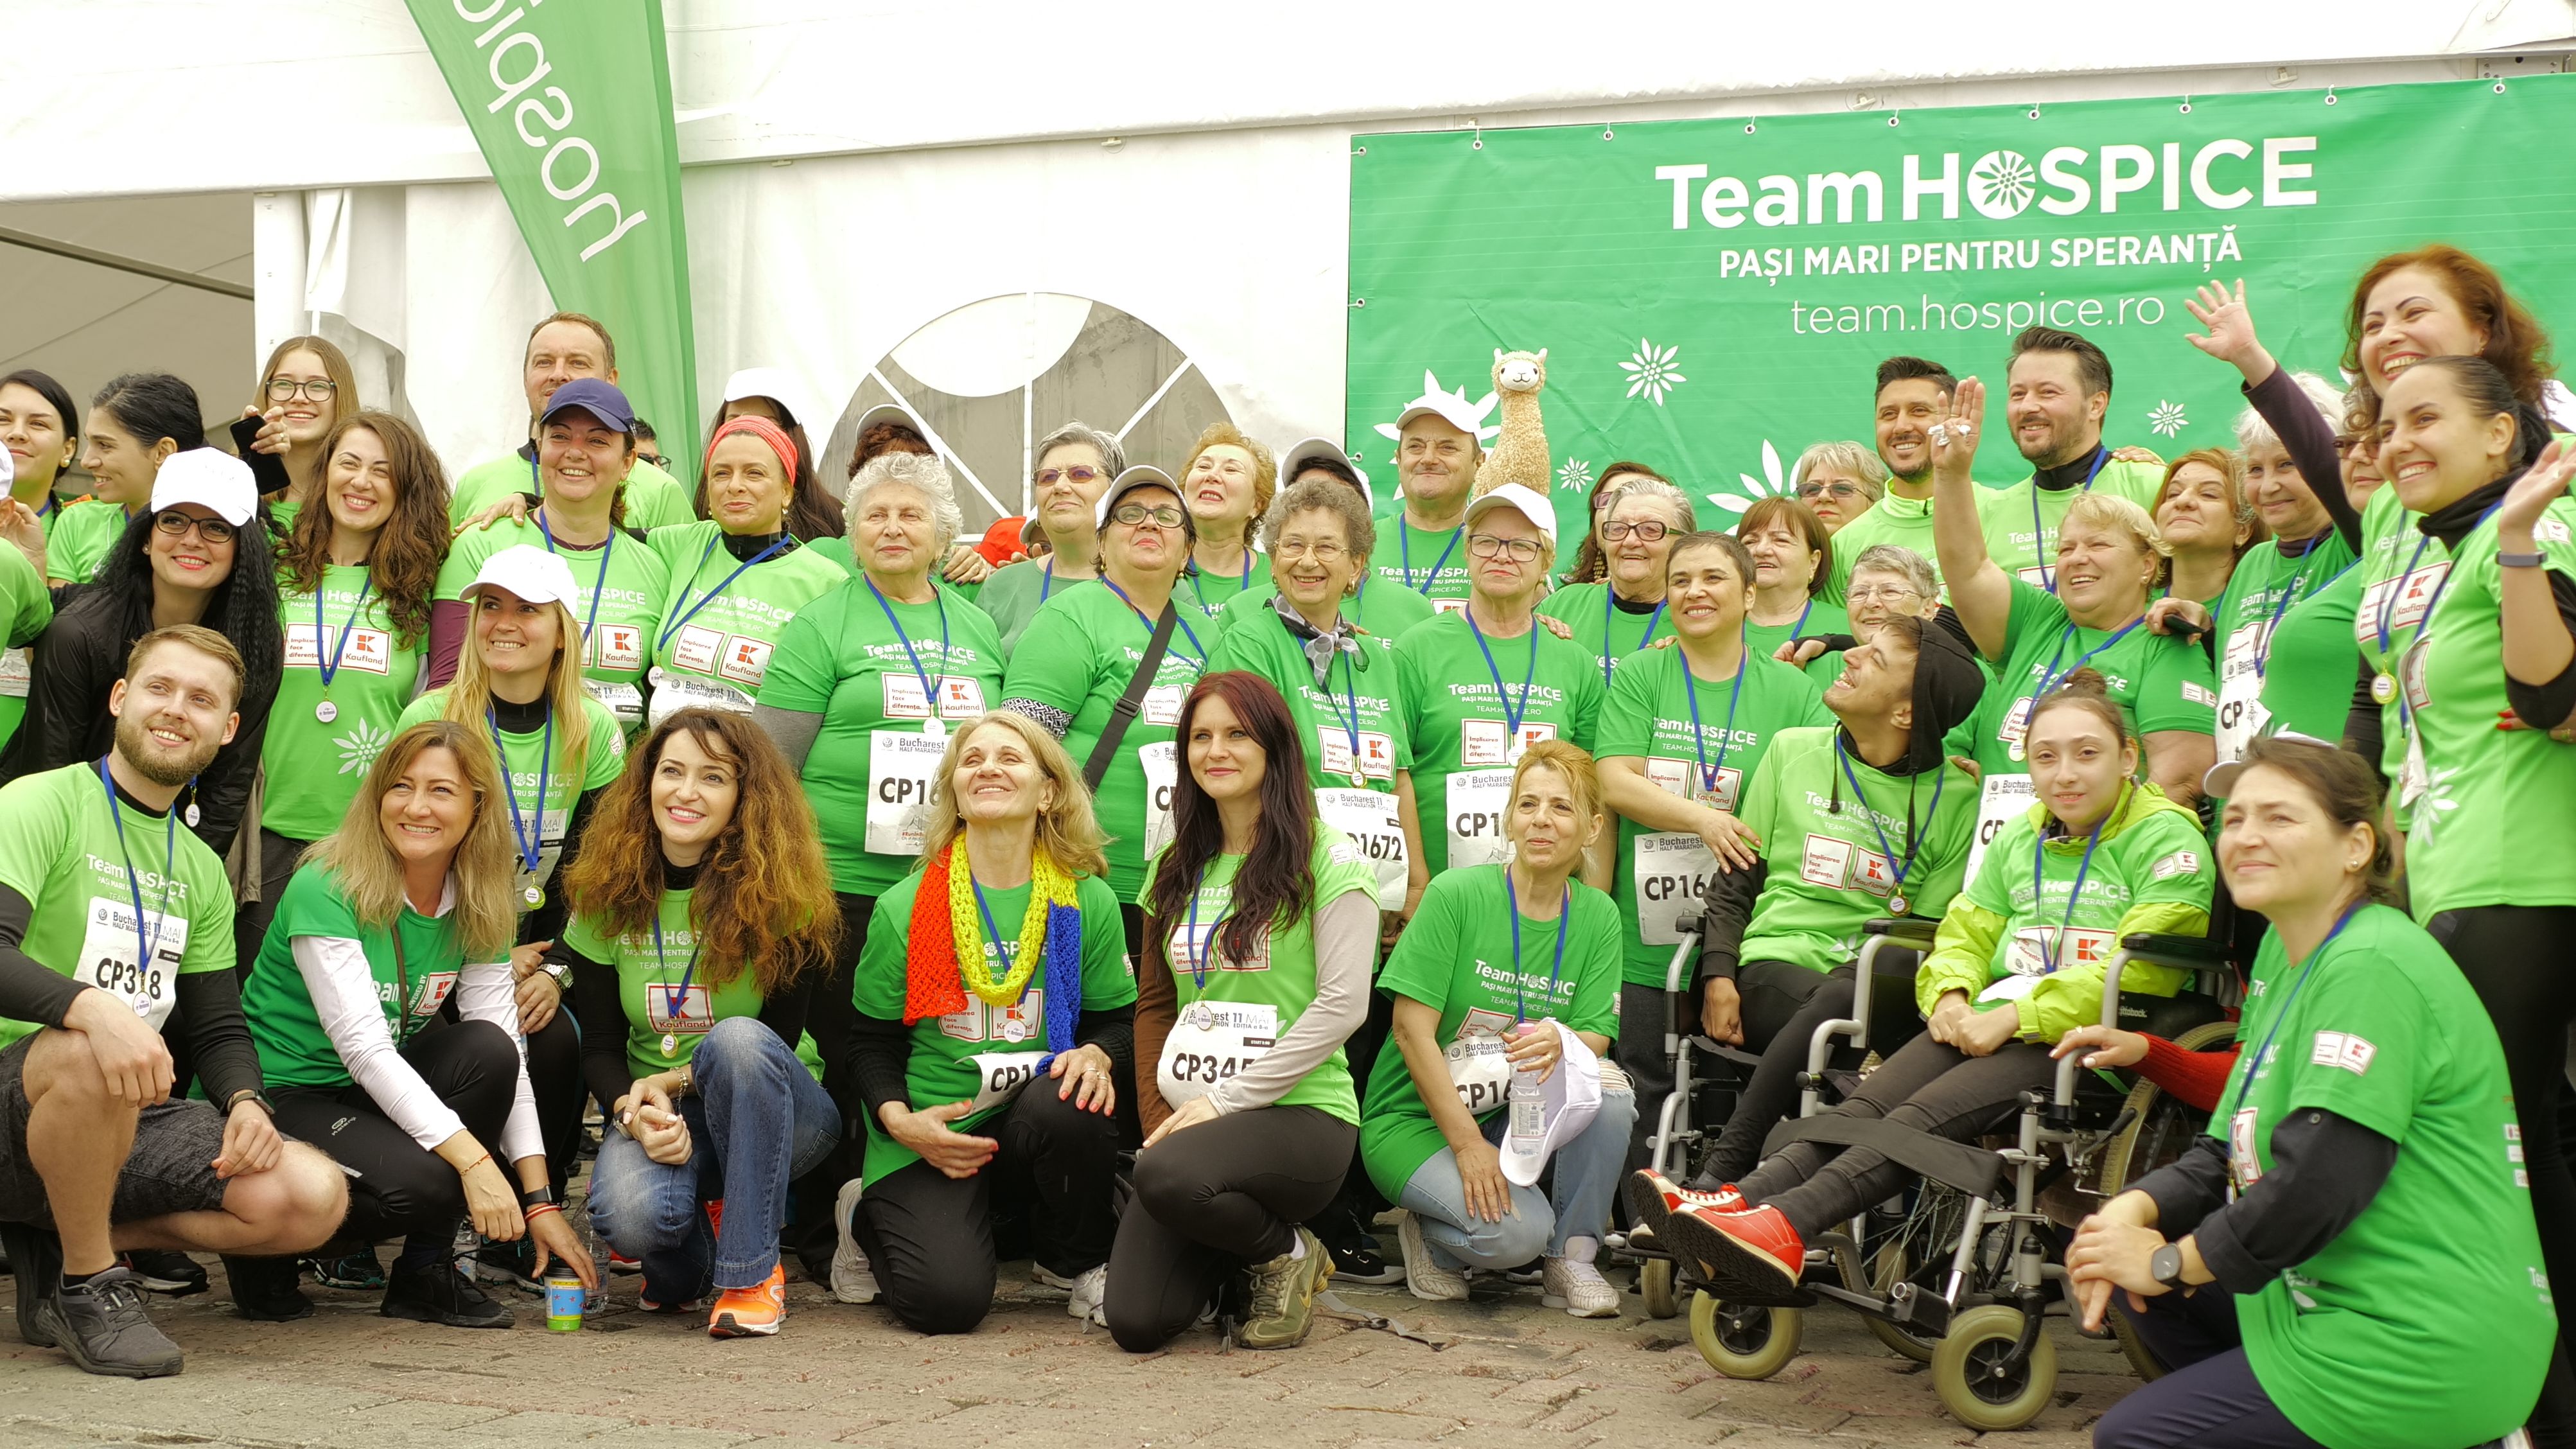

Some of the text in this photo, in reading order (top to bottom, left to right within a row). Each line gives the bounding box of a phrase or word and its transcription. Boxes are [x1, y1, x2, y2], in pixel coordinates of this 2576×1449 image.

[1655, 136, 2317, 230] Team HOSPICE
[1721, 224, 2242, 287] PAȘI MARI PENTRU SPERANȚĂ
[1791, 292, 2164, 335] team.hospice.ro
[2397, 603, 2428, 615] Kauflan
[863, 643, 906, 657] Team
[346, 653, 383, 665] Kaufland
[606, 653, 638, 662] Kaufland
[725, 662, 762, 678] Kaufland
[727, 689, 735, 698] 11
[1448, 683, 1491, 696] Team
[2221, 701, 2243, 729] CP
[900, 737, 945, 749] Bucharest
[1363, 762, 1390, 771] Kaufland
[1473, 775, 1512, 784] Buchares
[2002, 779, 2035, 789] Buchare
[1340, 793, 1375, 804] Bucharest
[1813, 809, 1828, 818] PAȘI
[1848, 802, 1907, 834] HOSPIC
[1456, 812, 1500, 837] CP1
[1660, 837, 1703, 846] Bucharest
[1809, 852, 1840, 863] Implicarea
[86, 854, 125, 879] Team
[110, 881, 125, 890] MARI
[1645, 874, 1707, 900] CP16
[1854, 877, 1889, 890] Kaufland
[113, 911, 180, 939] Buchast 11 MAI
[1475, 959, 1516, 984] Team
[419, 974, 426, 985] BY
[1481, 981, 1495, 992] PAȘI
[1496, 985, 1512, 994] MARI
[1233, 1012, 1242, 1023] 11
[1246, 1014, 1269, 1024] MAI
[1465, 1041, 1506, 1052] Bucharest
[990, 1064, 1031, 1093] CP1
